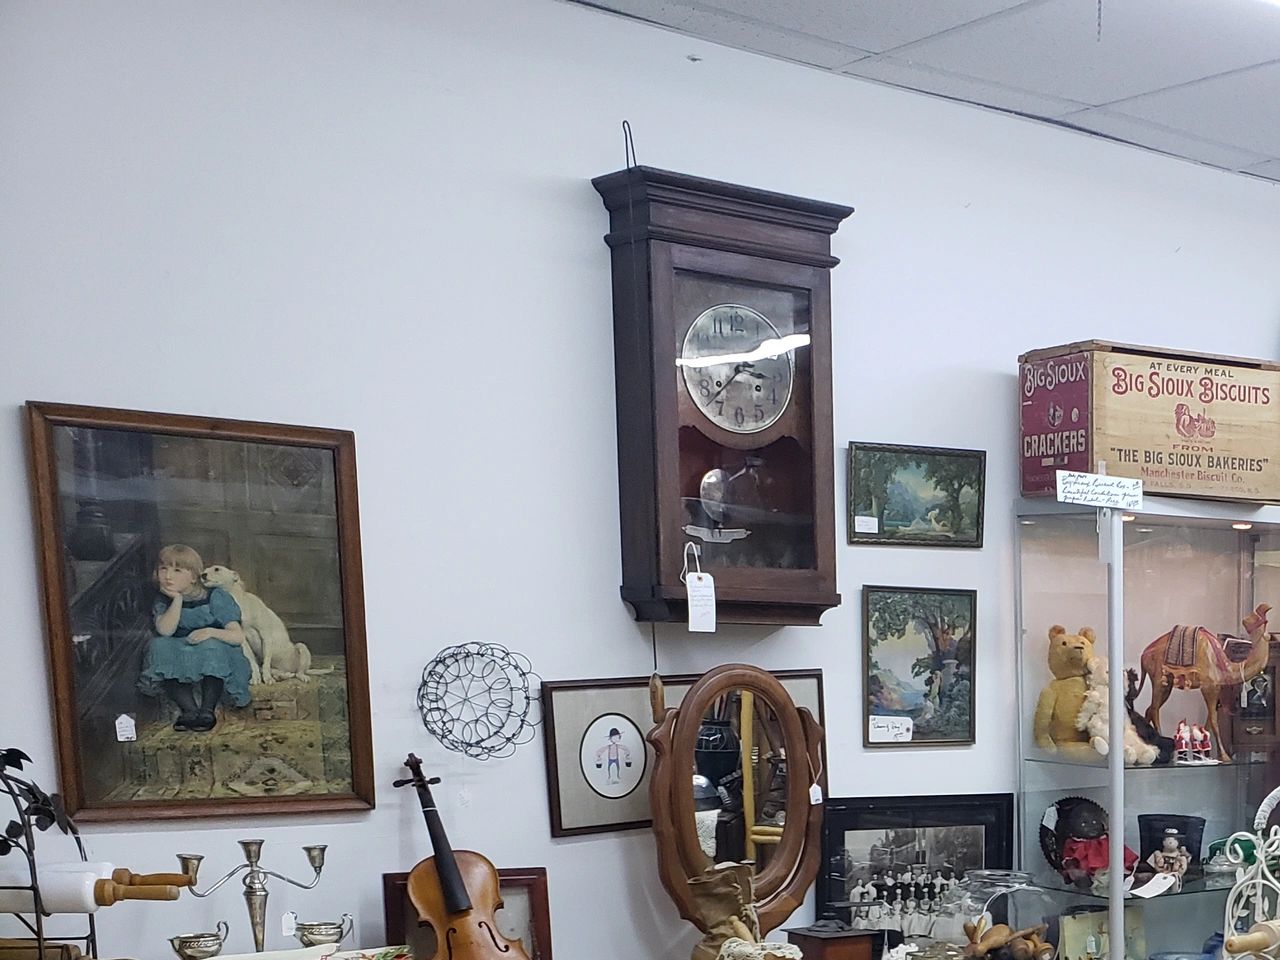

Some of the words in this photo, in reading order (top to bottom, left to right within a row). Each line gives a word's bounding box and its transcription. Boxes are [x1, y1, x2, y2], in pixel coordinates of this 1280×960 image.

[1046, 360, 1086, 391] SIOUX
[1149, 362, 1163, 371] AT
[1166, 363, 1199, 375] EVERY
[1204, 368, 1234, 379] MEAL
[1148, 371, 1194, 399] SIOUX
[1199, 376, 1271, 405] BISCUITS
[1024, 429, 1086, 458] CRACKERS
[1172, 444, 1214, 453] FROM
[1144, 451, 1163, 465] BIG
[1168, 452, 1201, 468] SIOUX
[1141, 466, 1194, 481] Manchester
[1197, 471, 1228, 484] Biscuit
